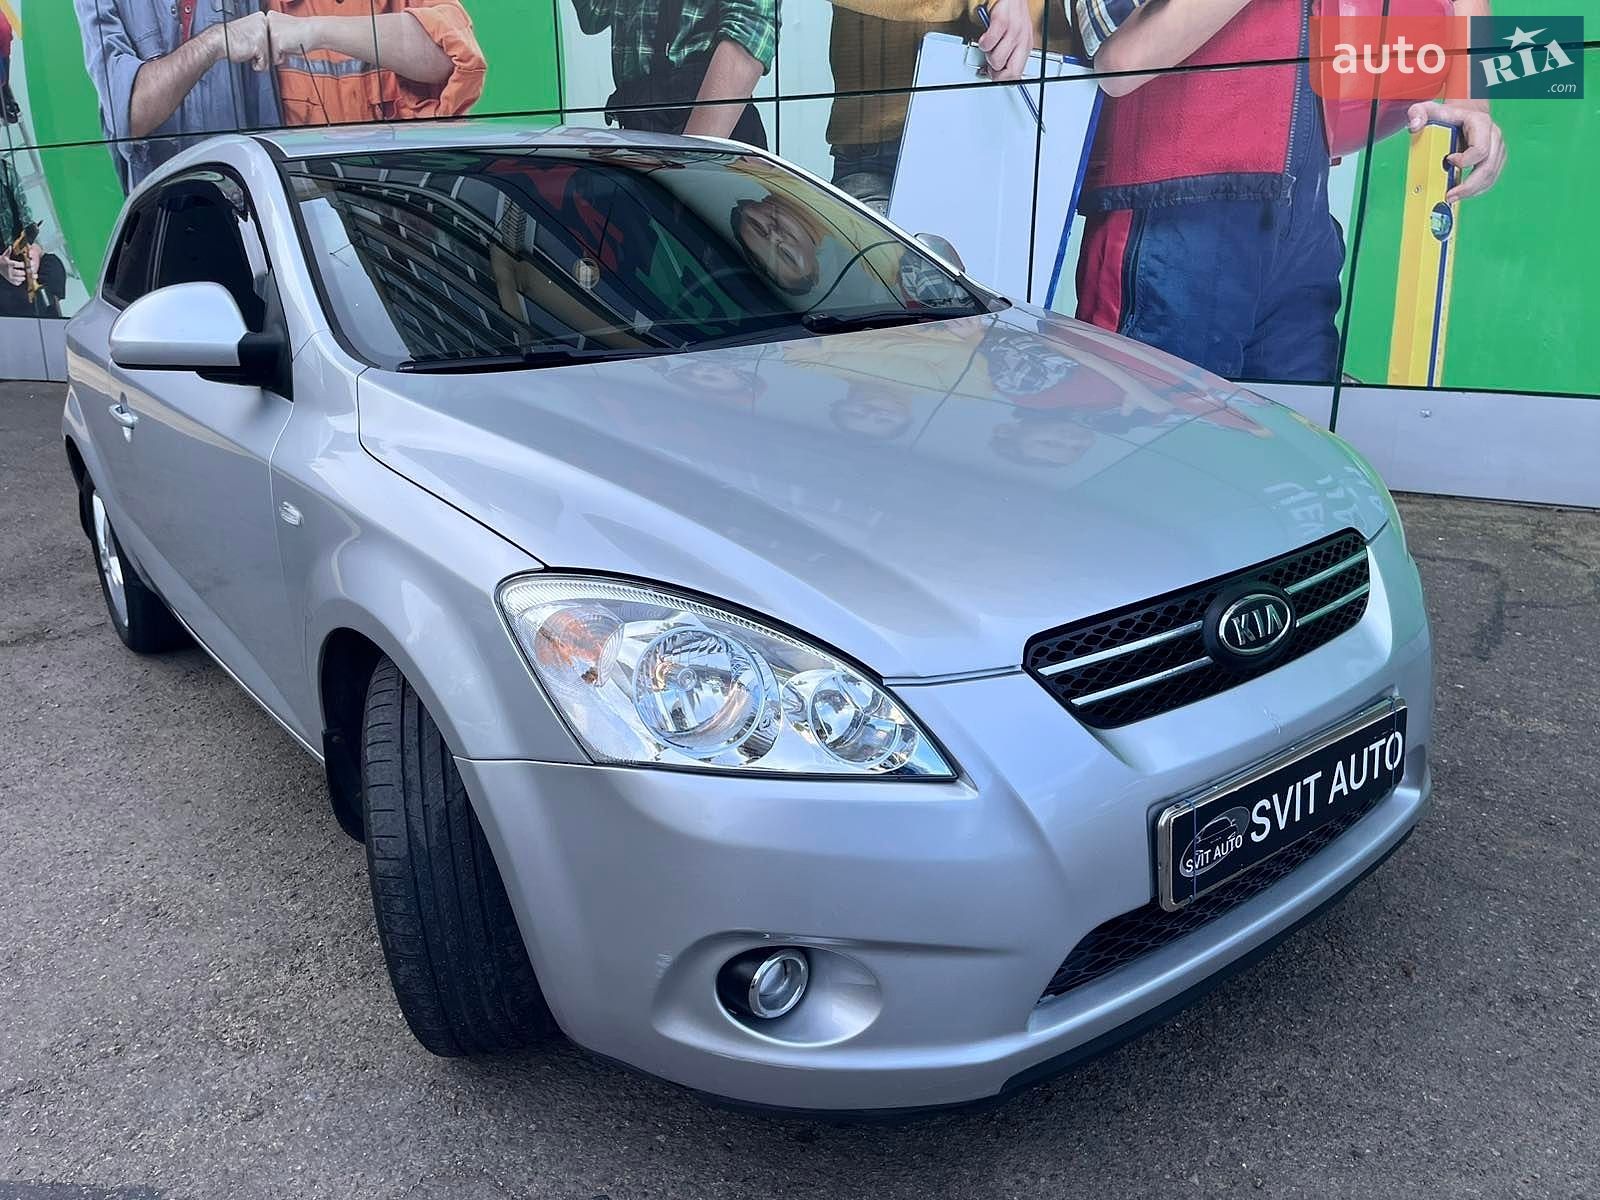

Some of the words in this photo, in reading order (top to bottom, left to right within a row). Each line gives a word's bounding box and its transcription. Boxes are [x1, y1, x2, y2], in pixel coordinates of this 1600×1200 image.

[1231, 603, 1284, 646] KIA
[1250, 770, 1322, 843] SVIT
[1327, 731, 1403, 804] AUTO
[1185, 848, 1212, 873] SVIT
[1213, 834, 1243, 860] AUTO
